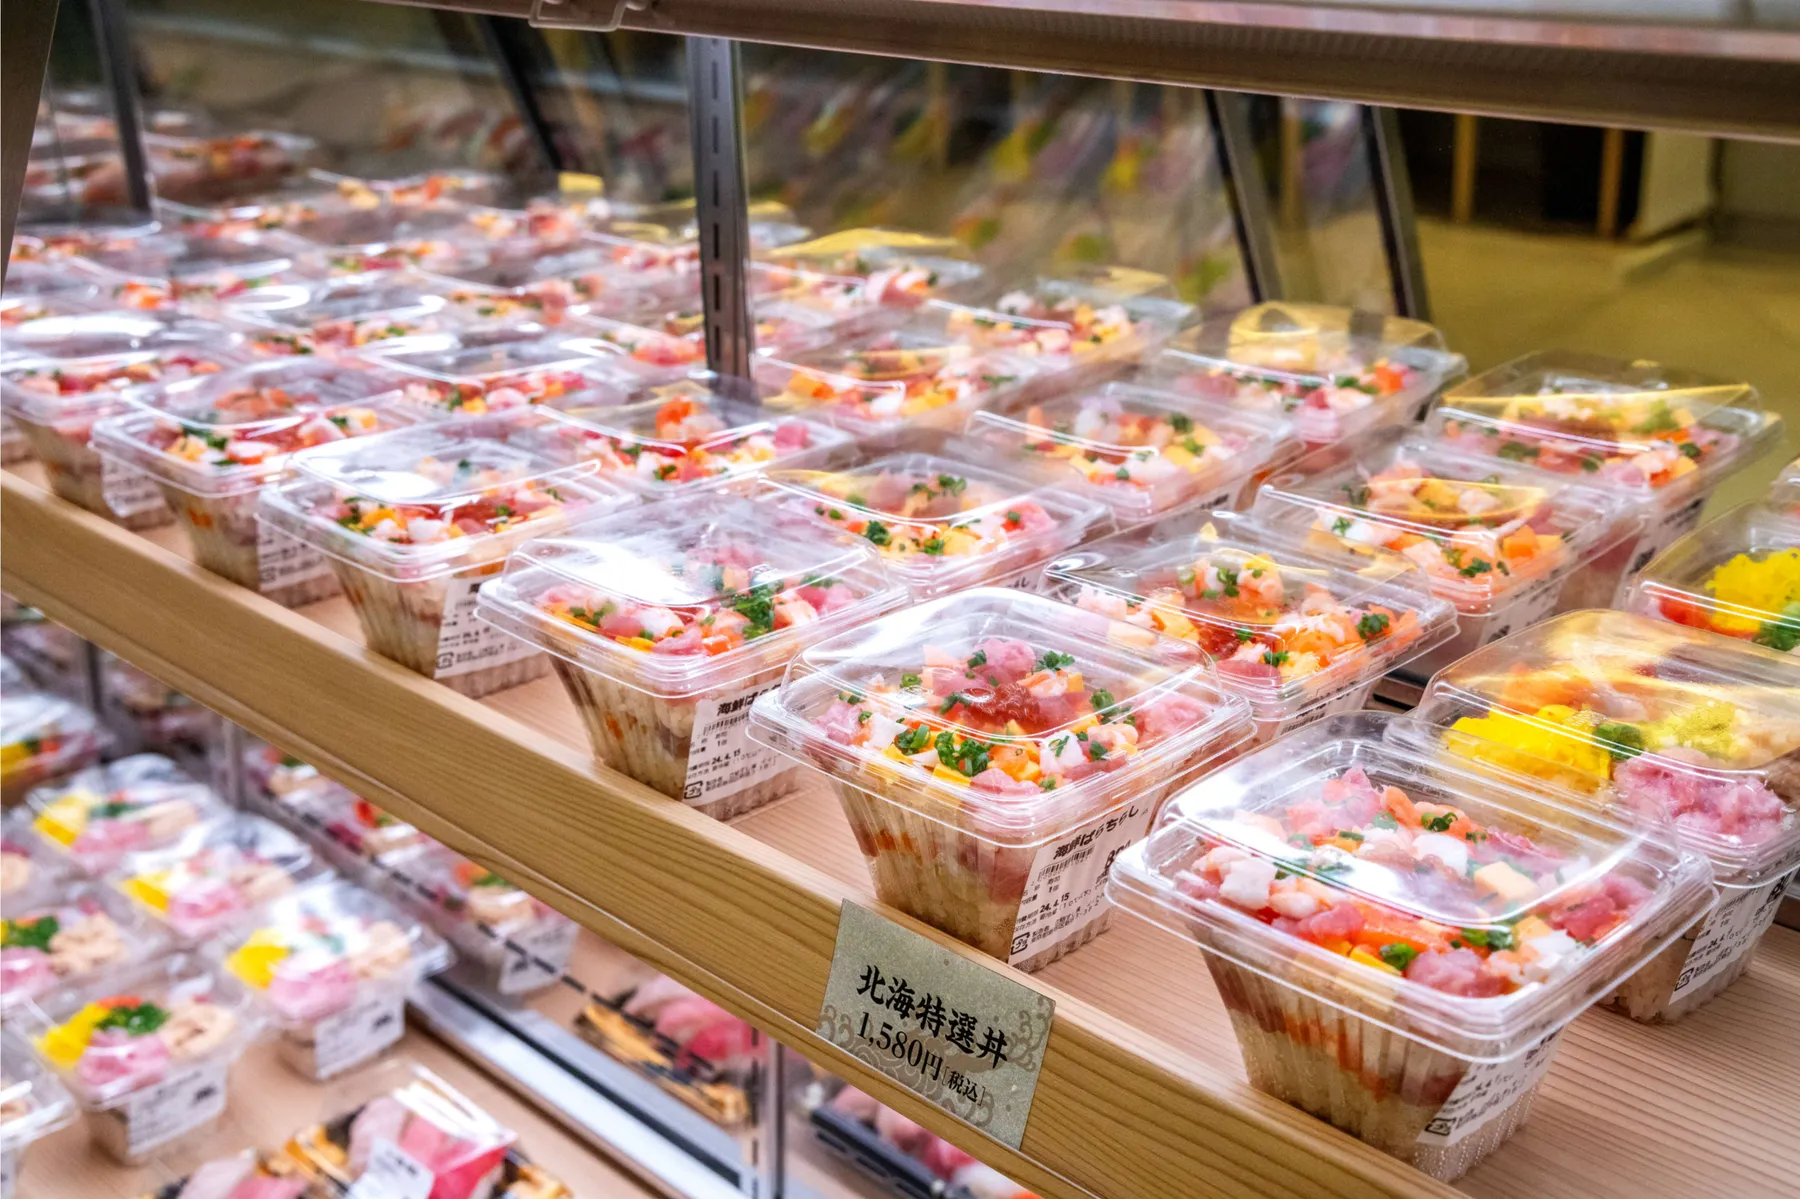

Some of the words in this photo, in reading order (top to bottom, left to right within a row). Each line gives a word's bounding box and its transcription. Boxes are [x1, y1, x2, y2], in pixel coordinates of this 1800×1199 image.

[857, 965, 1008, 1069] 北海特選丼
